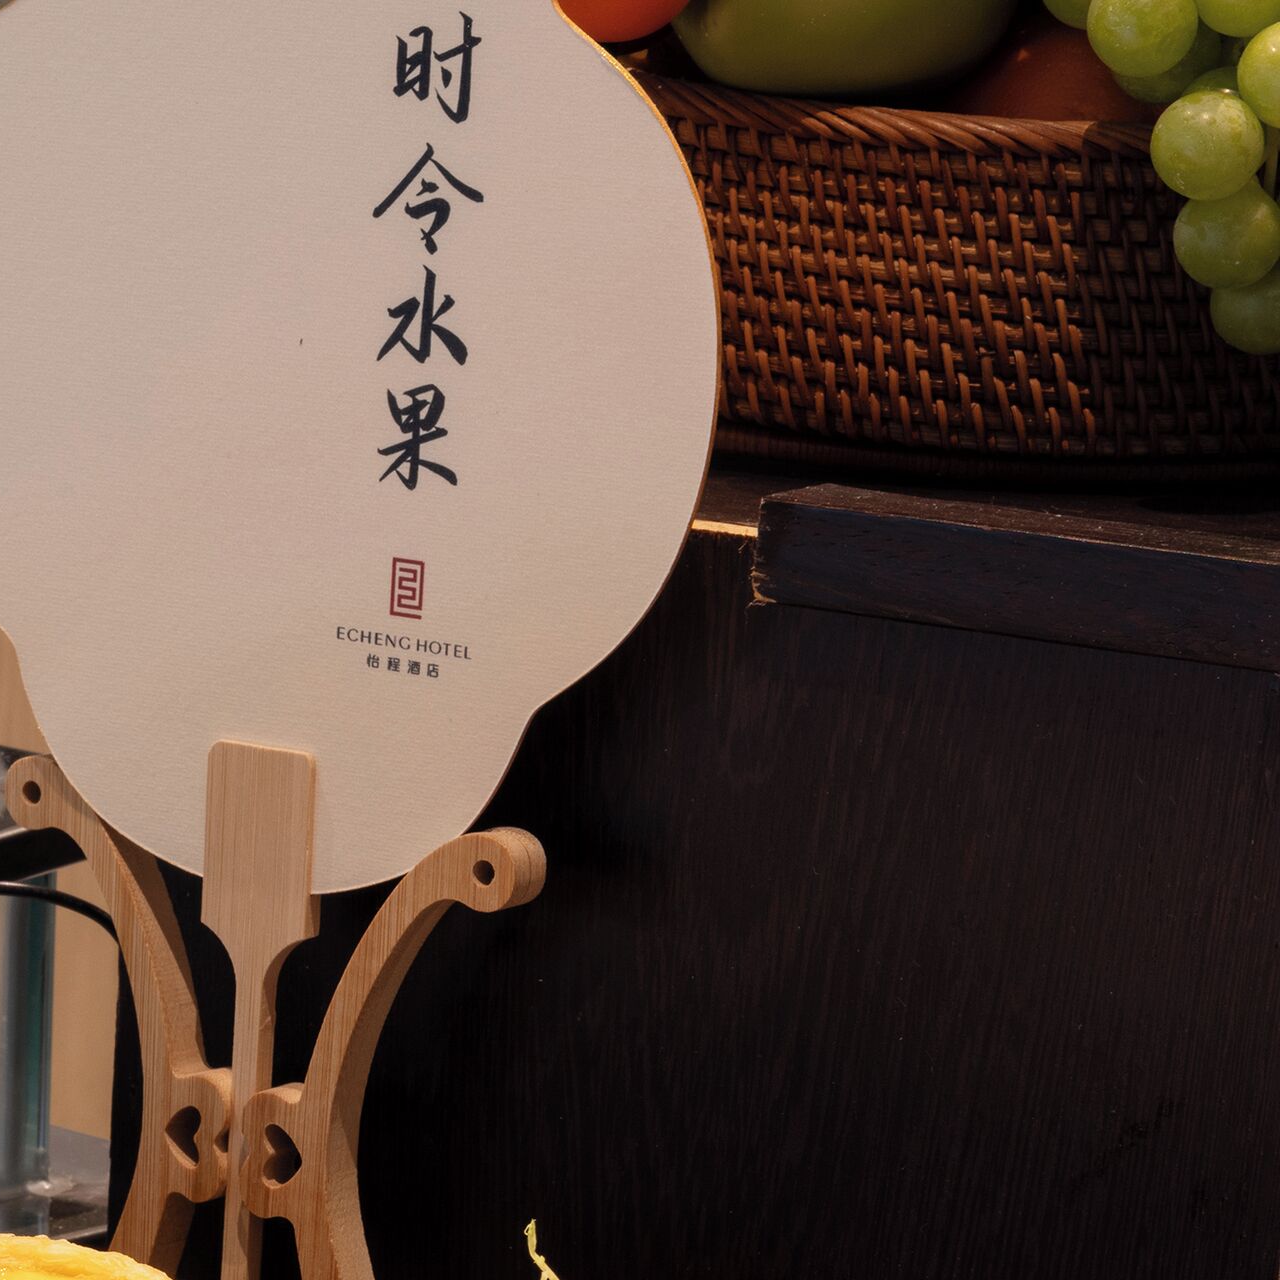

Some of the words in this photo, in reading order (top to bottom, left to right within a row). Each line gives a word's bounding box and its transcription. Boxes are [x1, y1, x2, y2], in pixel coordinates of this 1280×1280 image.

[372, 10, 485, 491] 时令水果
[336, 626, 411, 650] ECHENG
[415, 638, 472, 660] HOTEL
[366, 653, 440, 678] 怡程酒店
